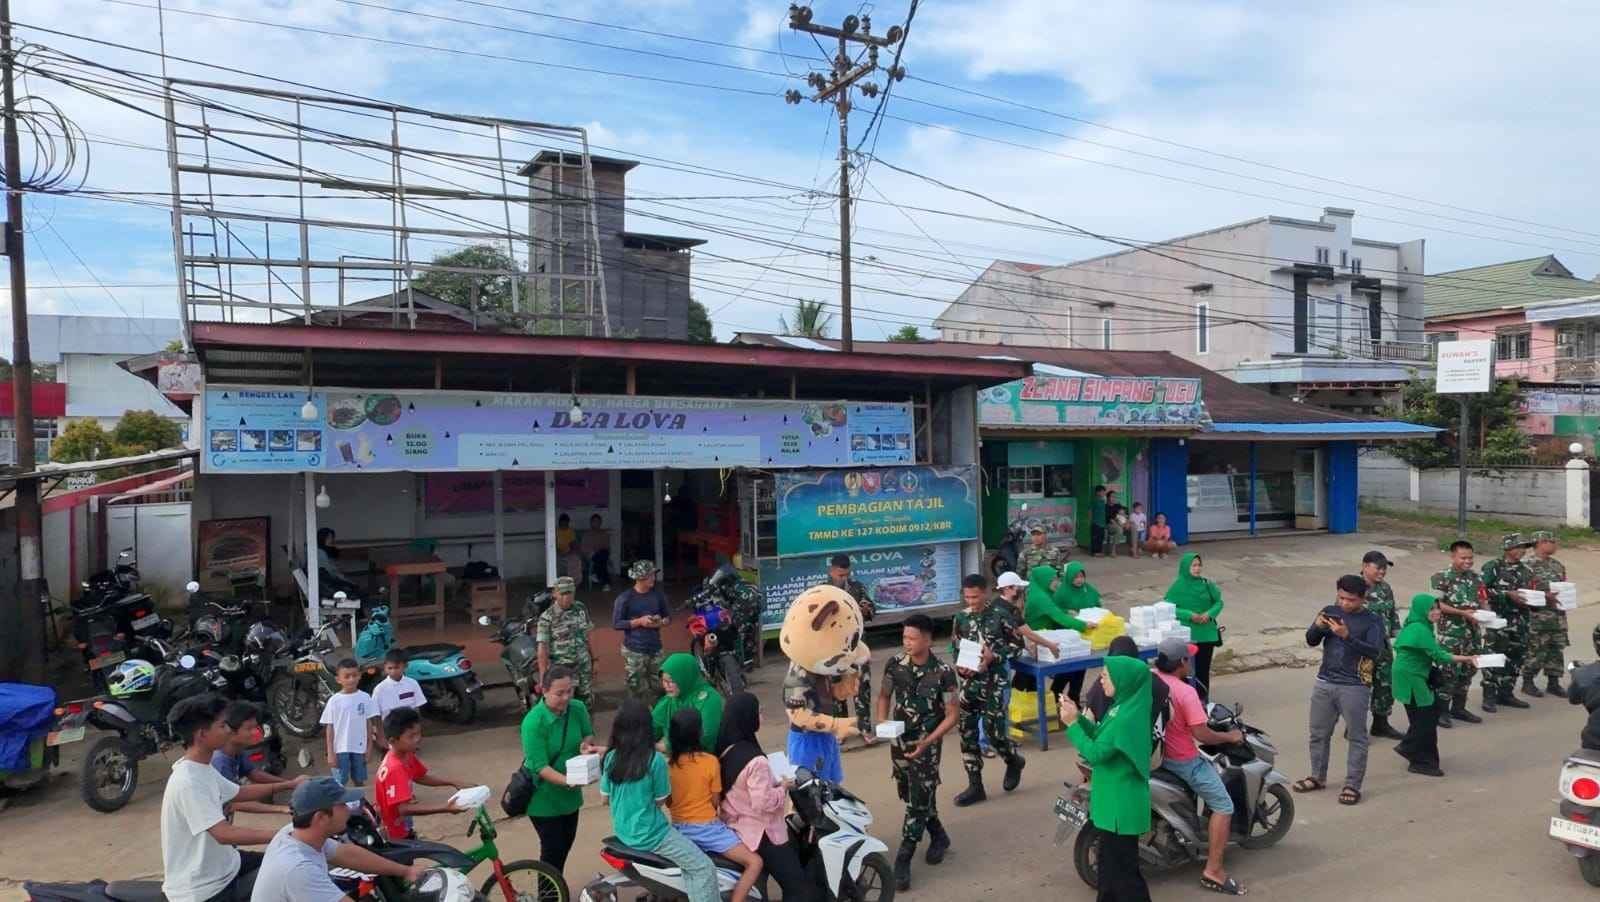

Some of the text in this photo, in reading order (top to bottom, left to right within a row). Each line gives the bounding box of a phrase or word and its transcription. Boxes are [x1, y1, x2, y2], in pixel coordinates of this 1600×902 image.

[1083, 378, 1153, 402] SIMPANG
[613, 412, 687, 430] LOVA
[817, 499, 902, 516] PEMBAGIAN
[809, 530, 839, 540] TMMD
[840, 528, 855, 537] KE
[857, 527, 873, 536] 127
[875, 524, 907, 535] KODIM
[908, 520, 952, 533] 0912/KBR
[862, 551, 903, 563] LOVA
[766, 582, 805, 591] LALAPAN
